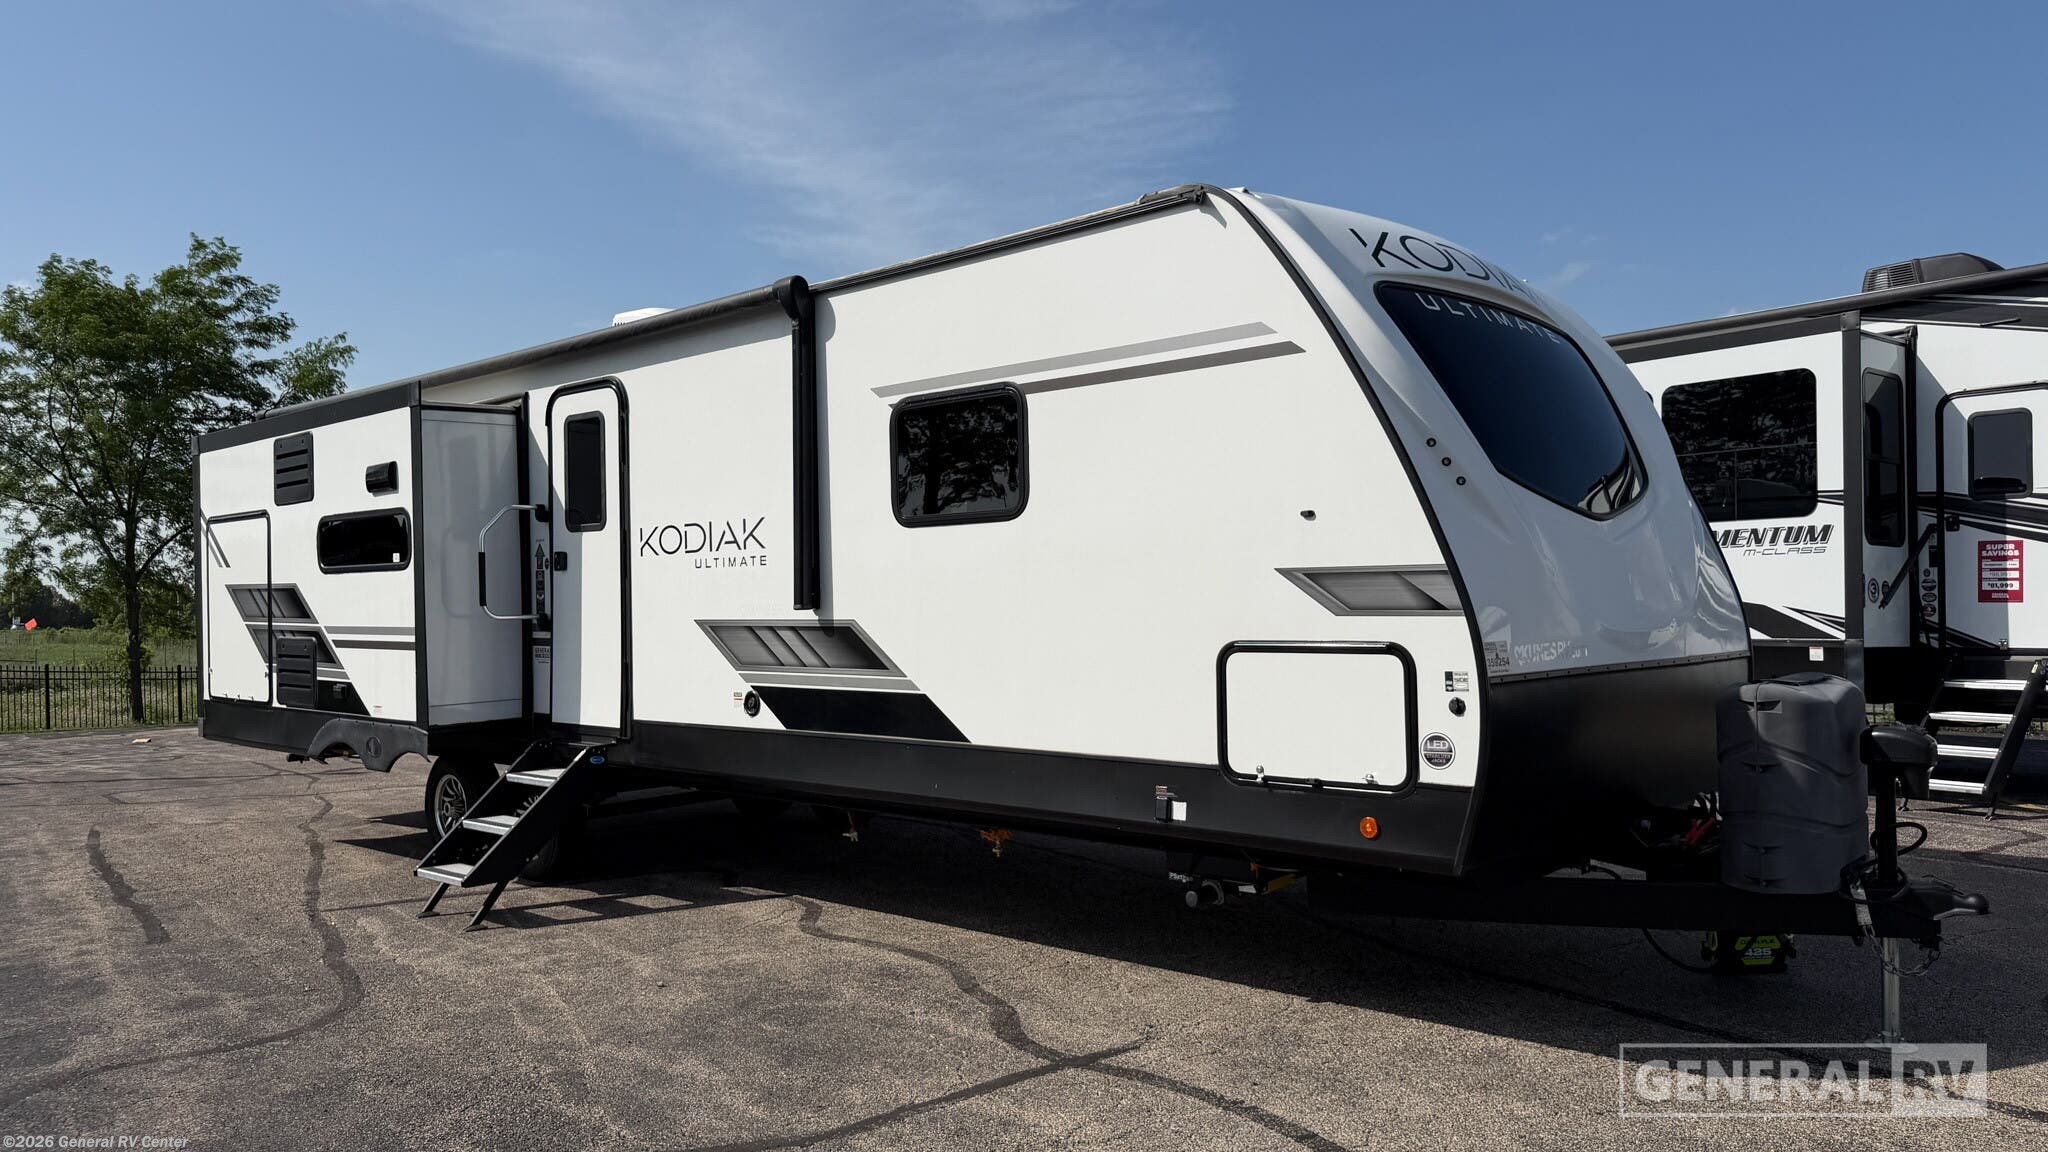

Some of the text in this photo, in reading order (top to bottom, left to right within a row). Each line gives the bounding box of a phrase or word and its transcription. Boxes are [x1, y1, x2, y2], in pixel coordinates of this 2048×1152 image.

[1347, 227, 1539, 303] KODIA
[1415, 292, 1561, 344] ULTIMATE
[639, 516, 766, 557] KODIAK
[694, 555, 767, 569] ULTIMATE
[1426, 740, 1449, 749] LED
